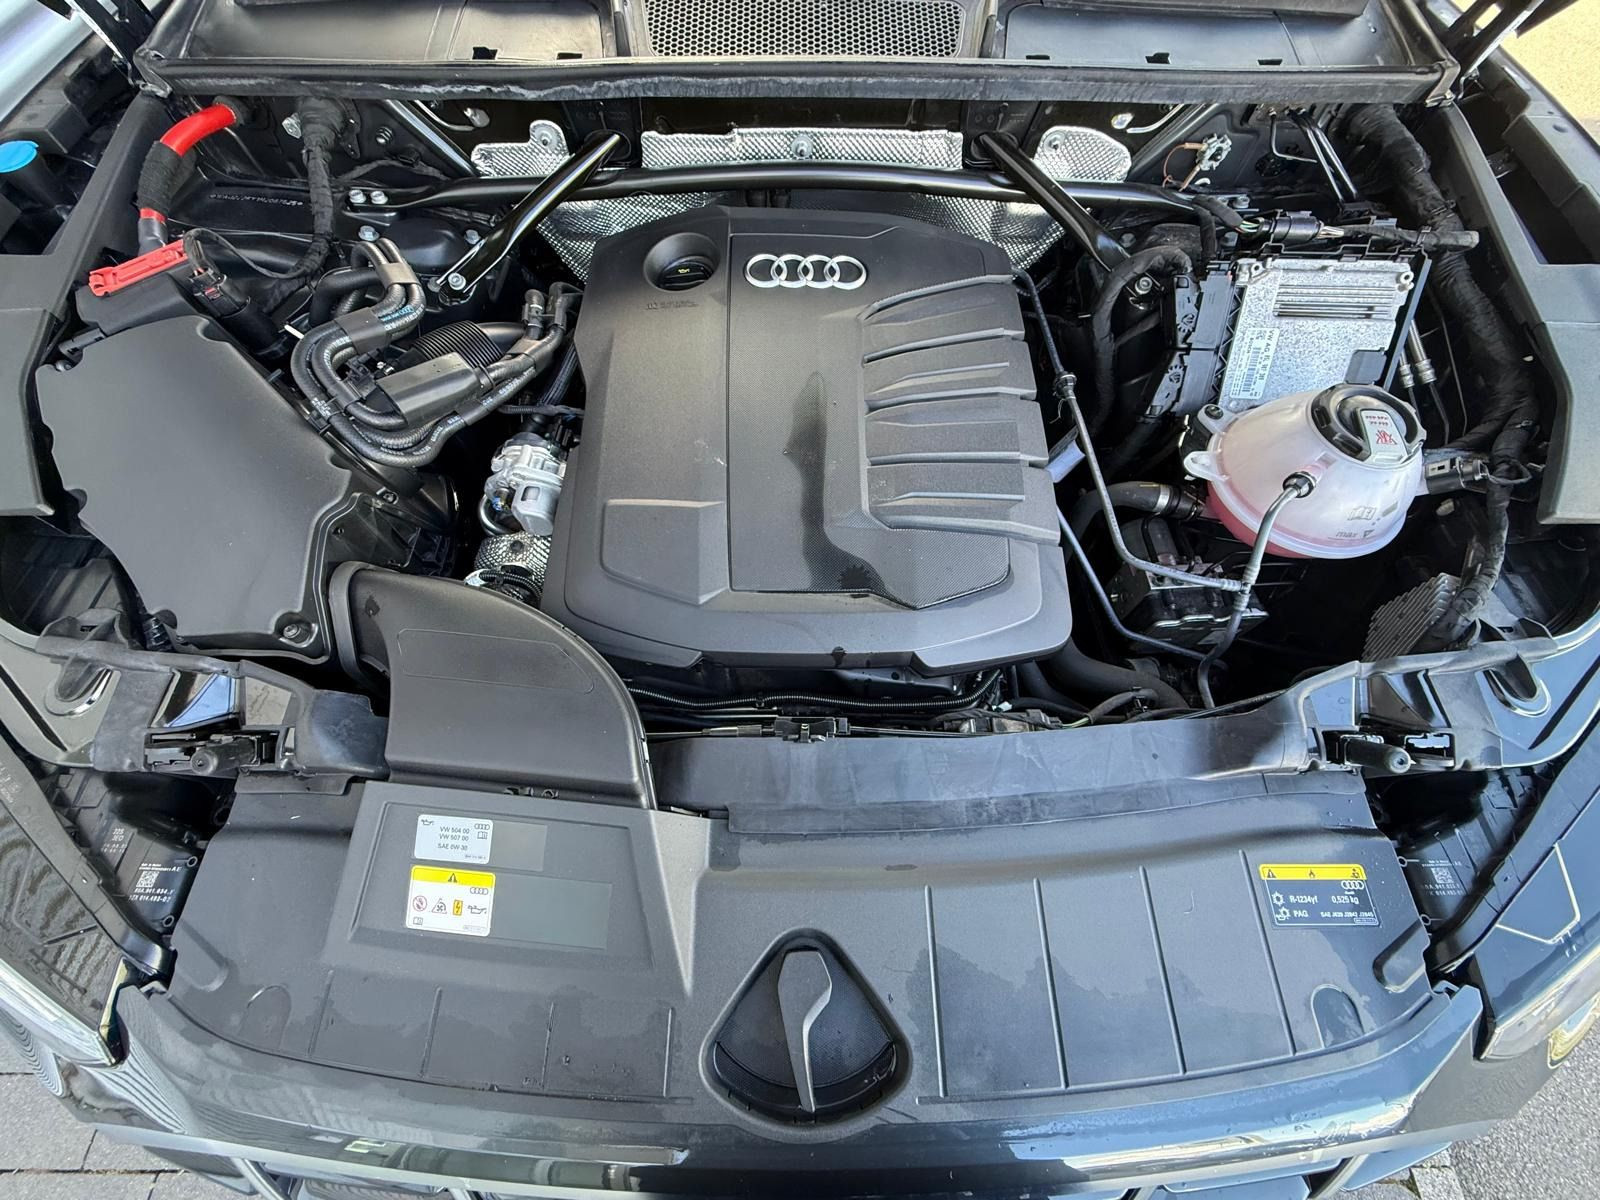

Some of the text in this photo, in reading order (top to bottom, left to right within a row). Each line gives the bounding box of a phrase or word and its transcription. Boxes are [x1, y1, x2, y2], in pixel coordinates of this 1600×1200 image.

[1246, 337, 1254, 354] BOSCH
[1289, 895, 1359, 905] R-1234yf 0,525 kg
[1293, 910, 1309, 918] PAG
